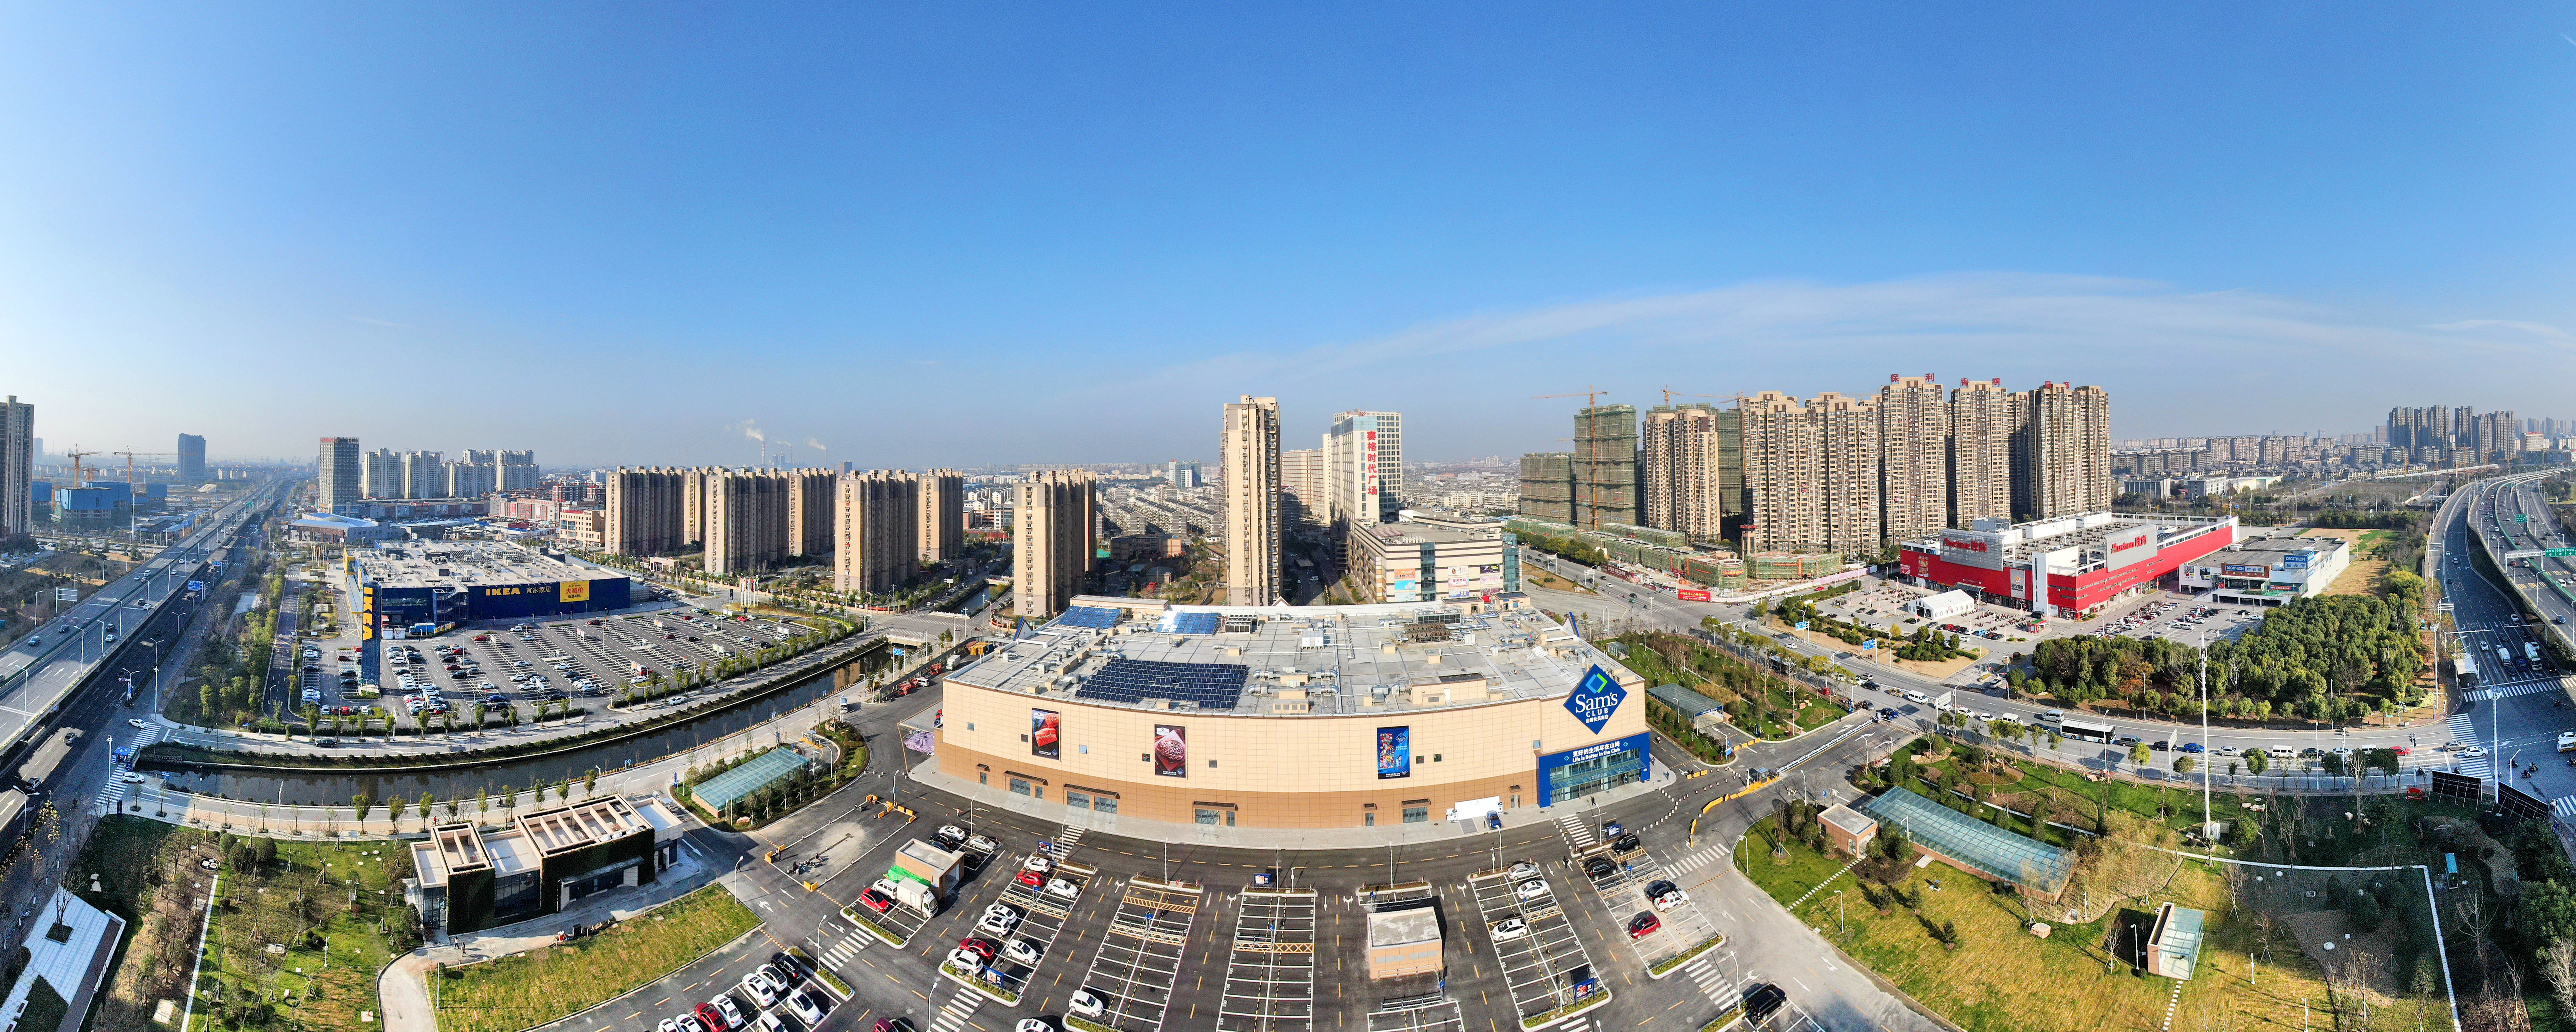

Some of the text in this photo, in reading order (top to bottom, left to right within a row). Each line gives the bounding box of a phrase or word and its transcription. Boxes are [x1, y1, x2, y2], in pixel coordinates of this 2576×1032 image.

[1367, 430, 1377, 495] 赛格时代广场
[1943, 538, 1970, 549] Auchan
[2111, 535, 2147, 554] Auchan 欧尚
[363, 587, 373, 641] IKEA
[1575, 692, 1618, 713] Sam's
[1586, 708, 1608, 717] CLUB
[1586, 714, 1608, 723] 山姆会员商店
[1573, 741, 1620, 757] 更好的生活尽在山姆
